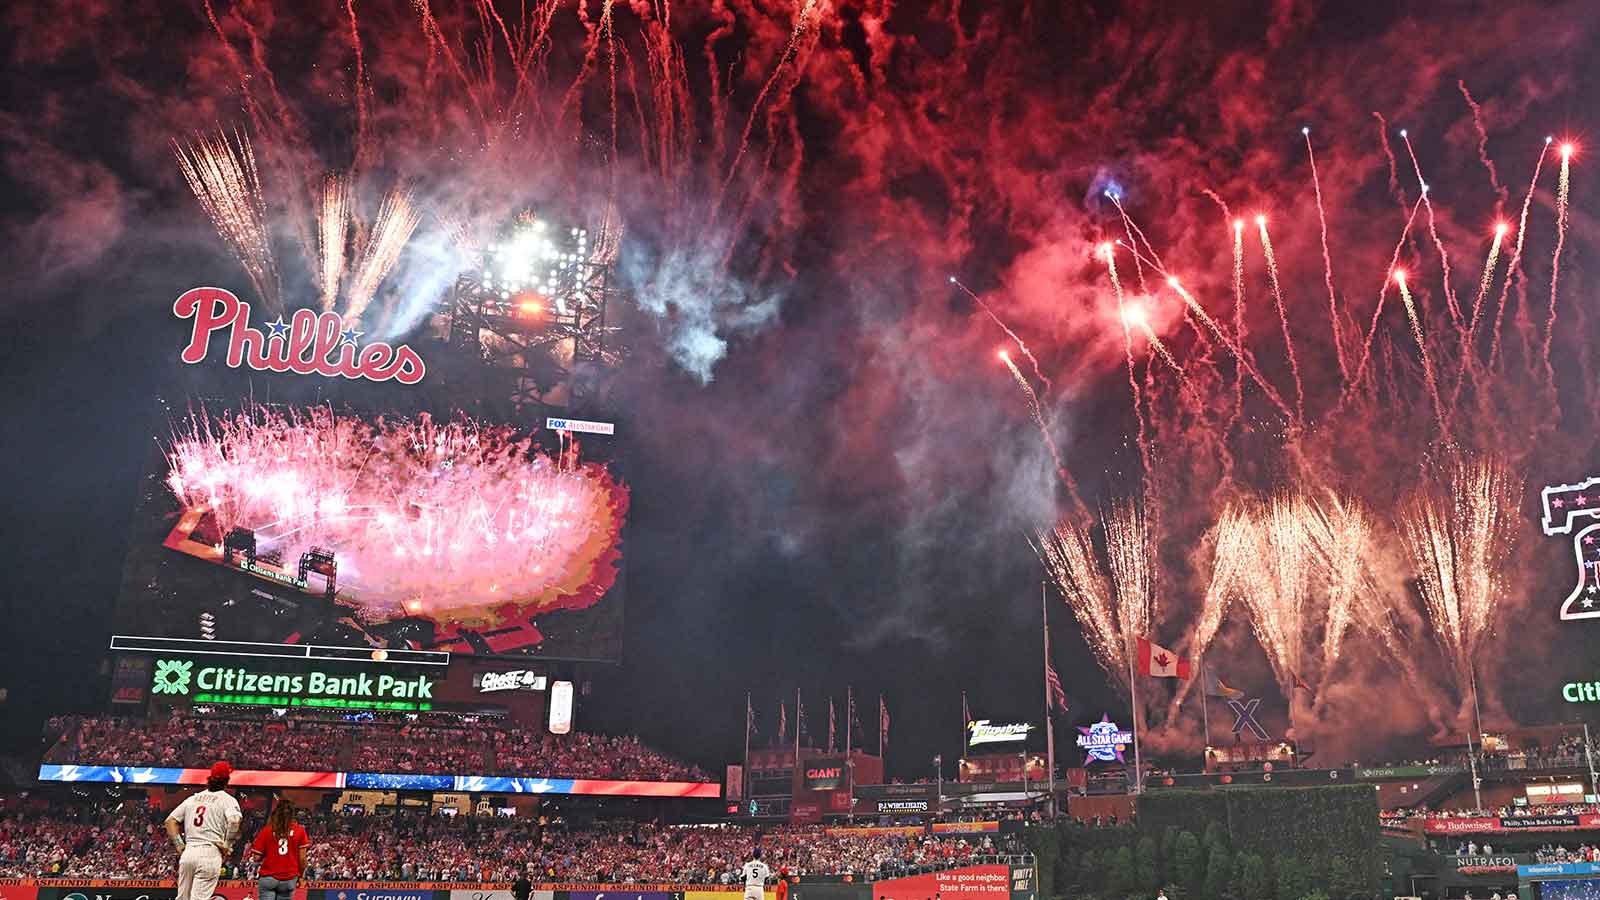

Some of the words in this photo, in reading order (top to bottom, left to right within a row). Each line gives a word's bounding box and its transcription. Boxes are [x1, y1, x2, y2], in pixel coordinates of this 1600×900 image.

[172, 286, 426, 385] Phillies
[549, 419, 566, 429] FOX
[249, 564, 275, 577] Citizens
[275, 573, 292, 583] Bank
[292, 577, 308, 588] Park
[197, 667, 303, 693] Citizens
[308, 672, 374, 697] Bank
[377, 675, 433, 698] Park
[1111, 732, 1132, 744] GAME
[806, 767, 842, 779] GIANT
[193, 805, 206, 827] 3
[1447, 820, 1493, 830] Budweiser
[1536, 818, 1551, 826] Bud's
[278, 838, 288, 855] 3
[1457, 857, 1517, 867] NUTRAFOL
[752, 868, 759, 879] 5
[936, 873, 950, 881] Like
[958, 874, 974, 882] good
[368, 881, 421, 889] ASPLUNDH
[431, 882, 481, 890] ASPLUNDH
[552, 883, 601, 891] ASPLUNDH
[940, 884, 958, 892] State
